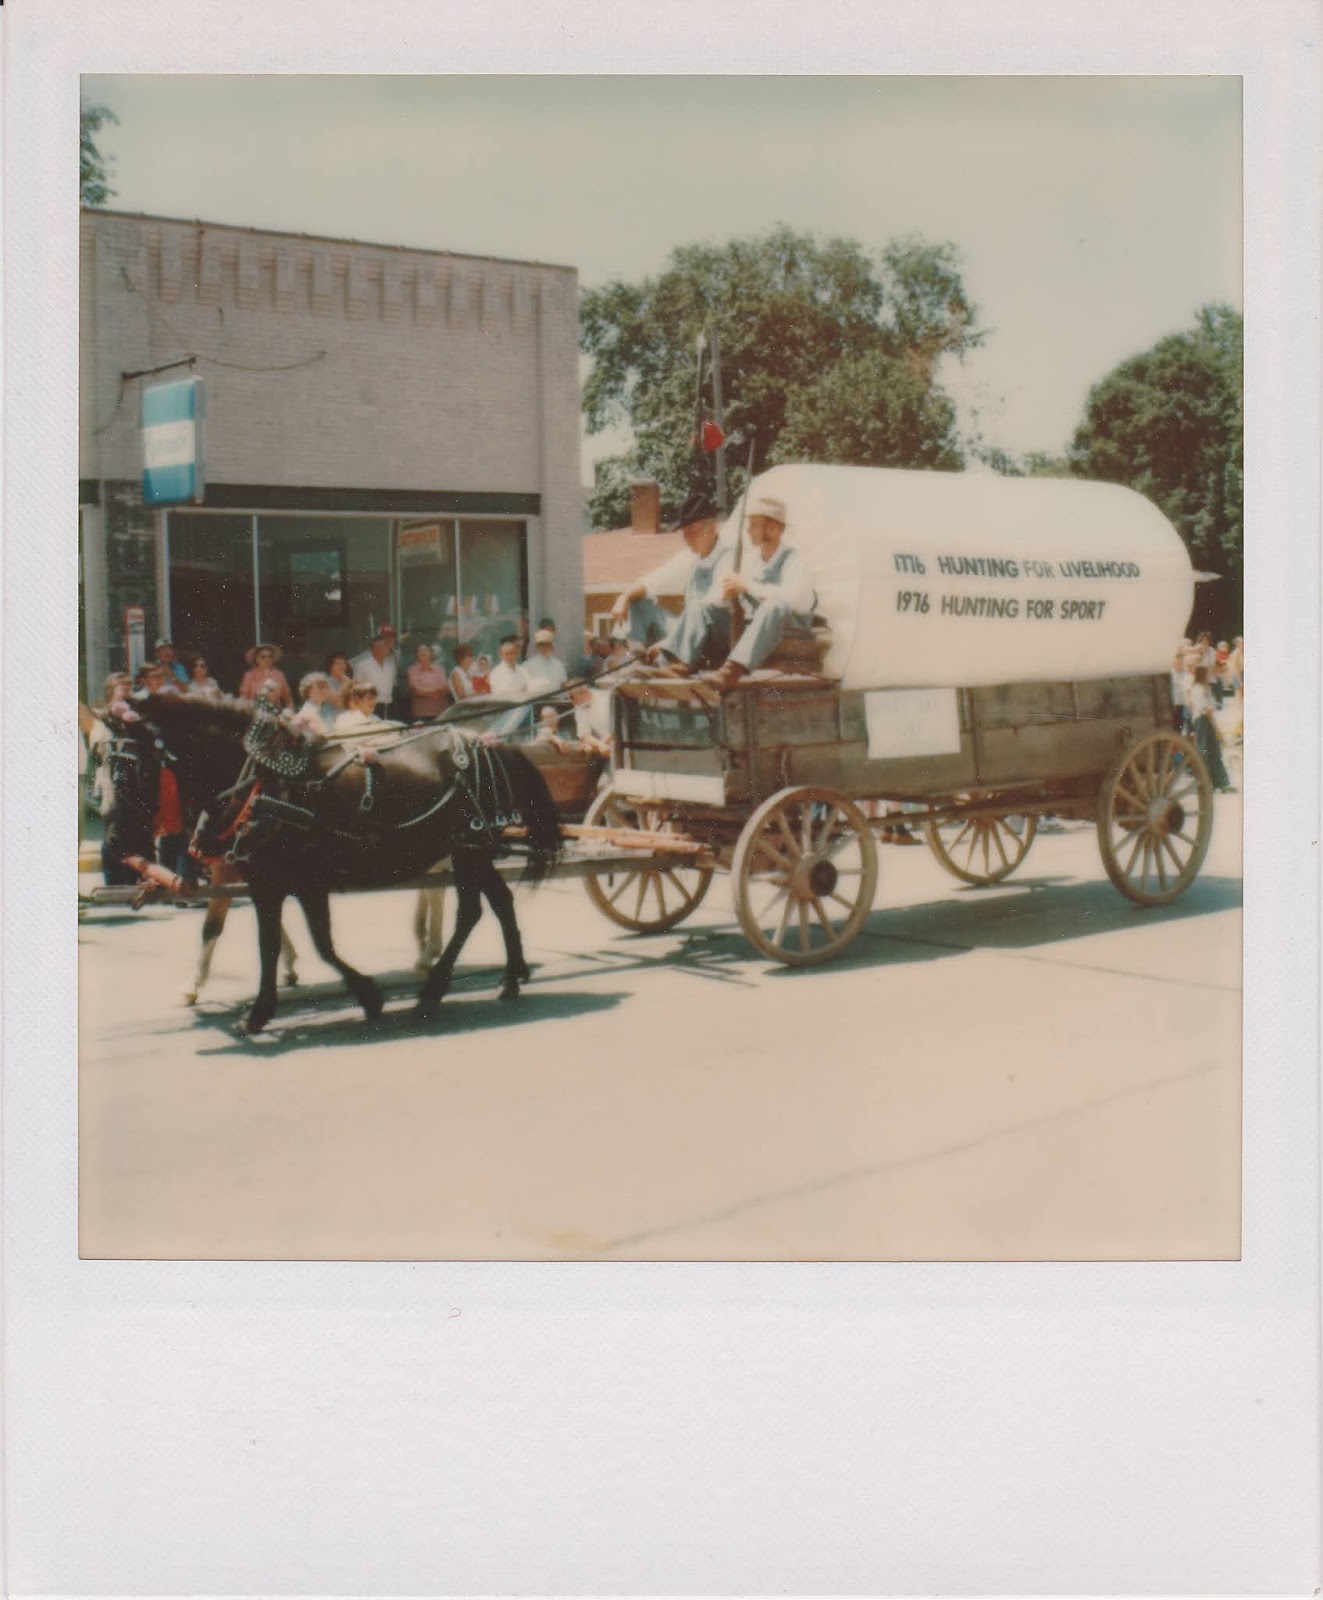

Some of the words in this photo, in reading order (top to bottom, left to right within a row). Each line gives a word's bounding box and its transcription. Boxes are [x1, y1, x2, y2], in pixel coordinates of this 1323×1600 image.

[893, 553, 926, 575] 1776
[937, 555, 1019, 578] HUNTING
[1022, 560, 1055, 578] FOR
[1059, 560, 1140, 578] LIVELIHOOD
[896, 590, 930, 614] 1976
[940, 594, 1019, 618] HUNTING
[1026, 599, 1055, 619] FOR
[1060, 600, 1106, 620] SPORT
